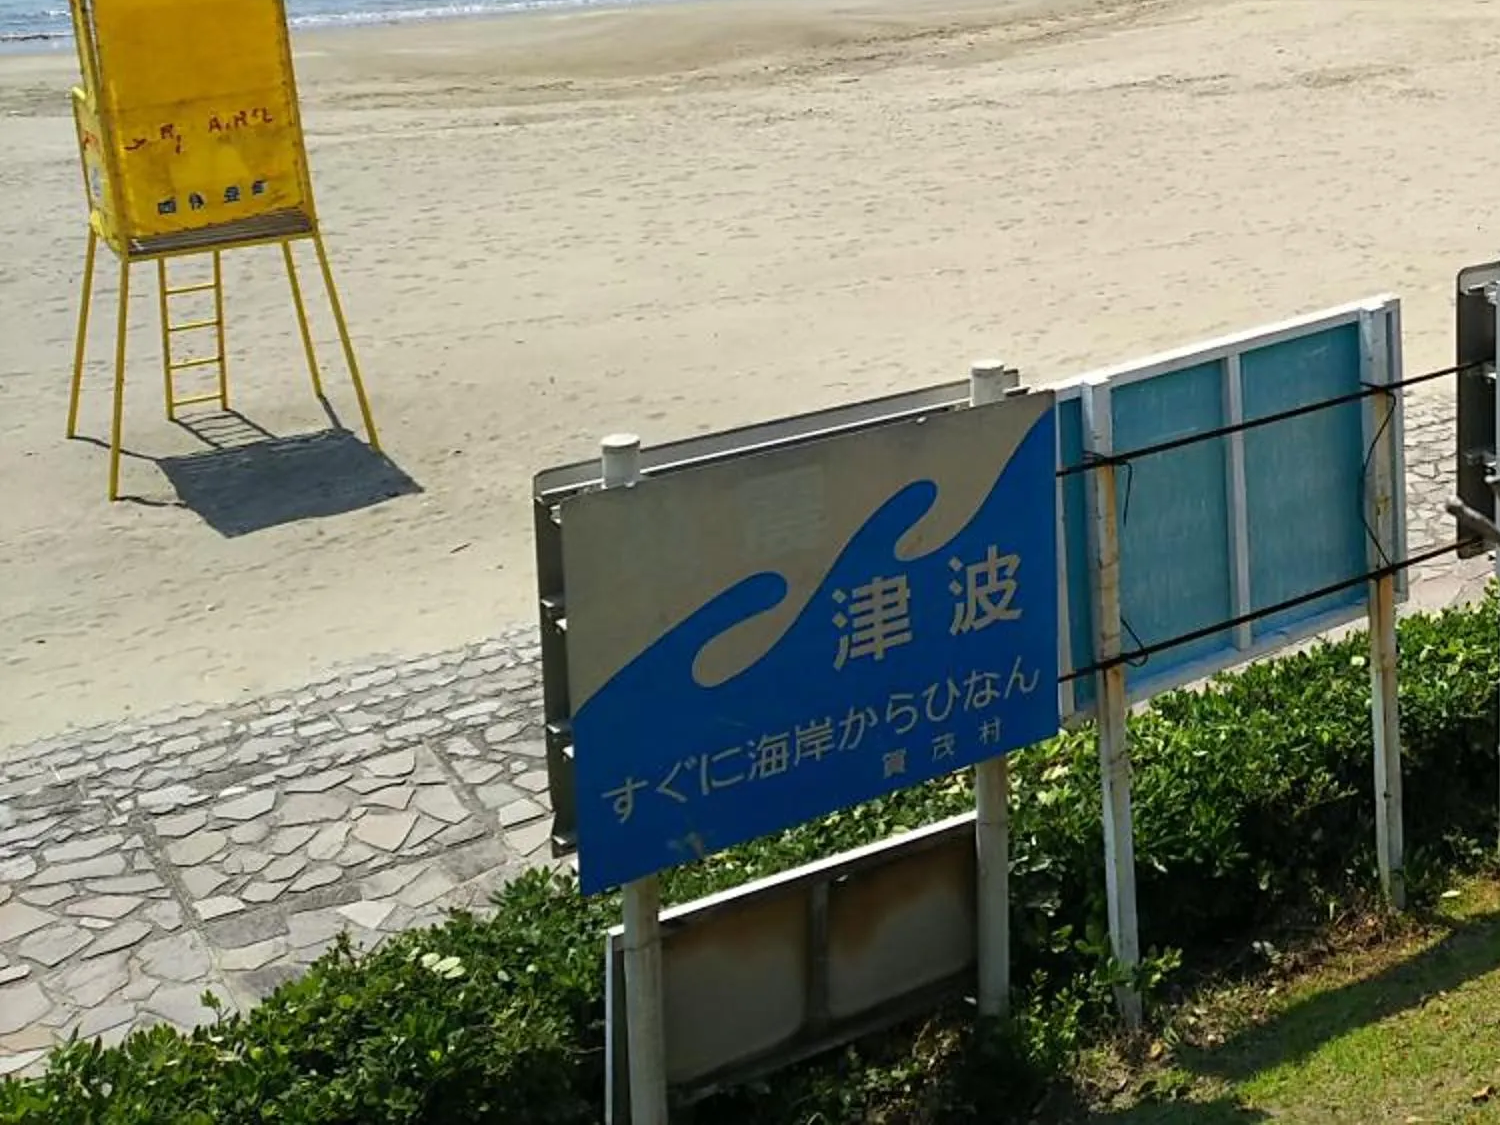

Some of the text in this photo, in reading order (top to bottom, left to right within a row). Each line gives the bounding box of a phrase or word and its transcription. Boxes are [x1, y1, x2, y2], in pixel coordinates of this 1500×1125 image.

[832, 544, 1023, 671] 津波
[602, 655, 1041, 825] すぐに海岸からひなん
[882, 716, 1004, 779] 賀茂村
